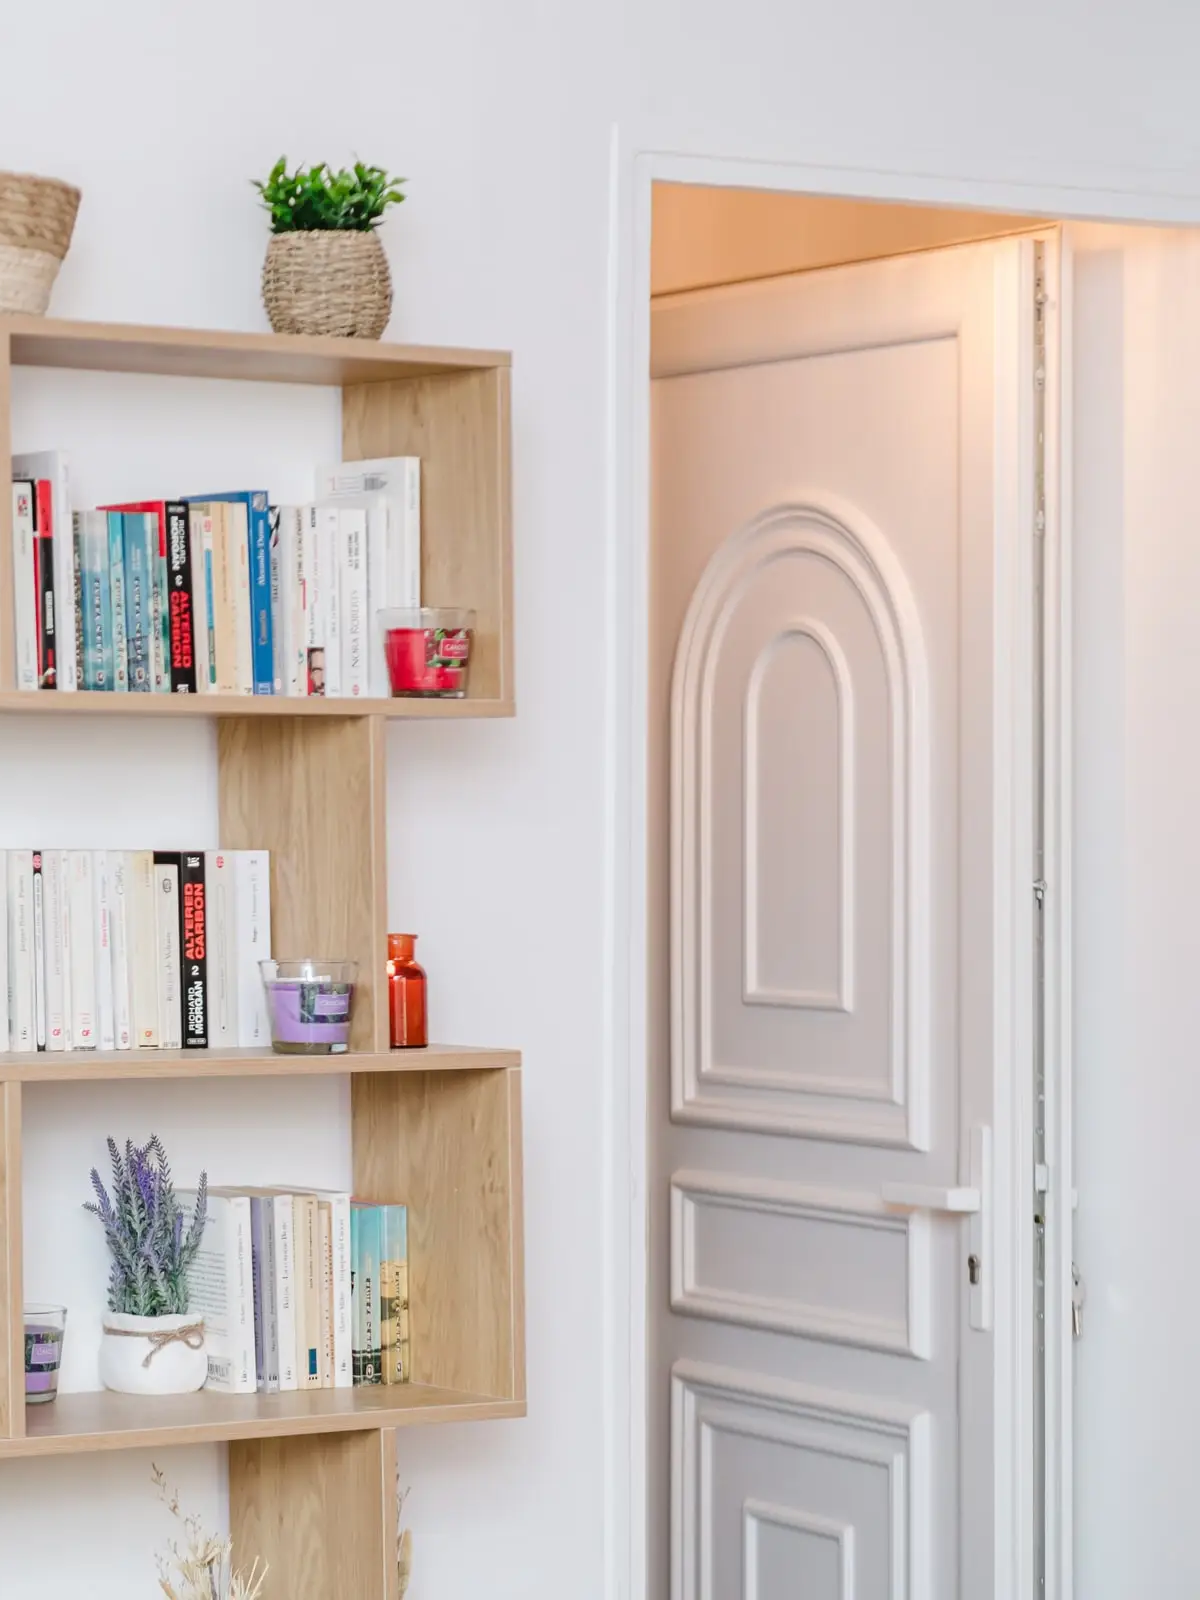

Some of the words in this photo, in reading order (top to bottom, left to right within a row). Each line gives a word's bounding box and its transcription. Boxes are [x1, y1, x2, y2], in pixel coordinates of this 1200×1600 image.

[171, 515, 183, 571] MORGAN
[177, 519, 187, 564] RICHARD
[170, 591, 182, 668] CARBON
[180, 591, 192, 668] ALTERED
[349, 590, 359, 634] ROBERTS
[351, 638, 360, 668] NORA
[184, 883, 195, 959] ALTERED
[194, 883, 205, 959] CARBON
[191, 965, 200, 976] 2
[187, 986, 196, 1031] RICHARD
[193, 980, 204, 1035] MORGAN
